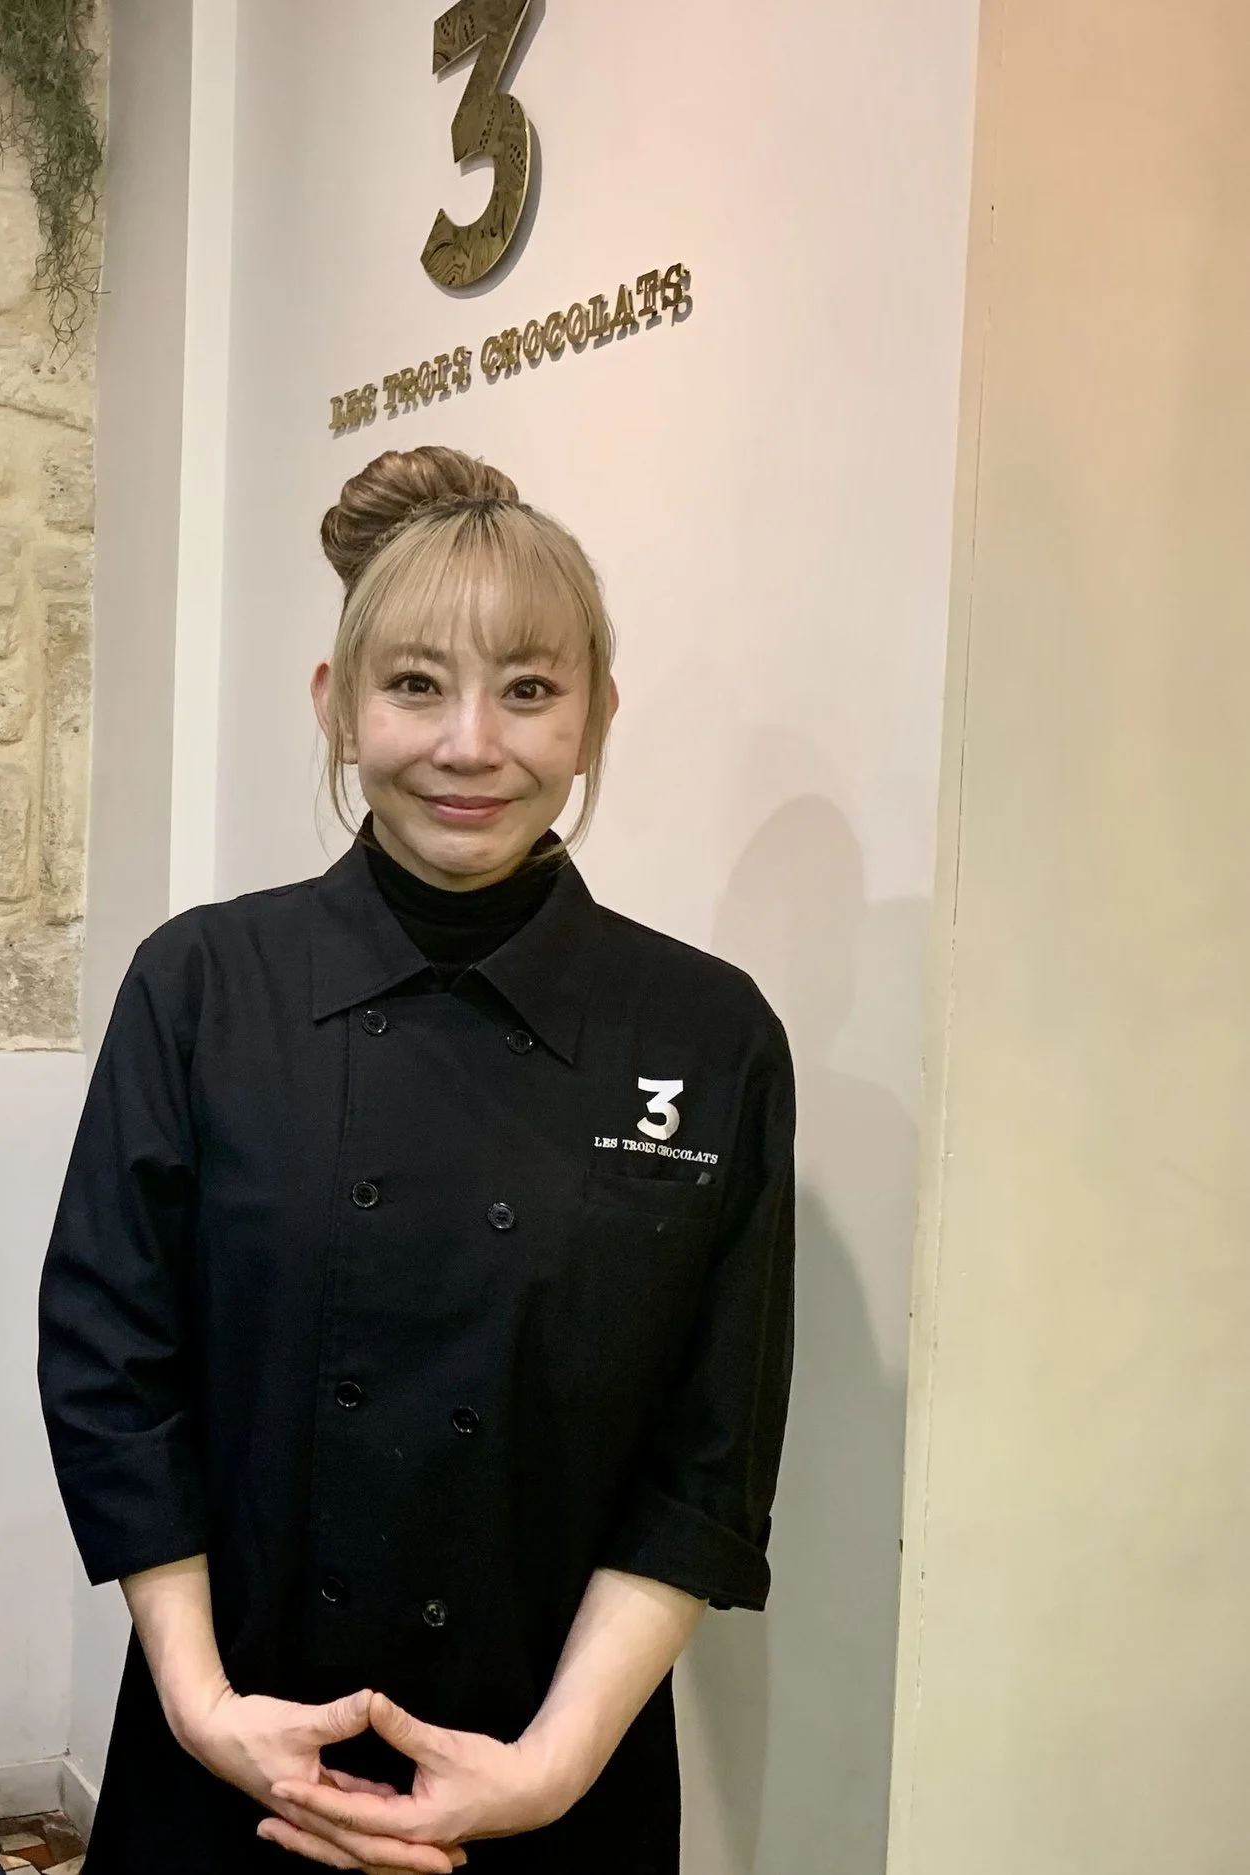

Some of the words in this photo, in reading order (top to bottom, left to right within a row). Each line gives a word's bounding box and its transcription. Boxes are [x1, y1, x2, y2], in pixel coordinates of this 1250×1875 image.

[420, 0, 531, 288] 3
[329, 383, 378, 430] LES
[383, 346, 472, 411] TROIS
[480, 263, 690, 375] CHOCOLATS
[594, 1136, 618, 1149] LES
[622, 1139, 656, 1154] TROIS
[657, 1145, 718, 1164] CHOCOLATS
[636, 1076, 684, 1141] 3
